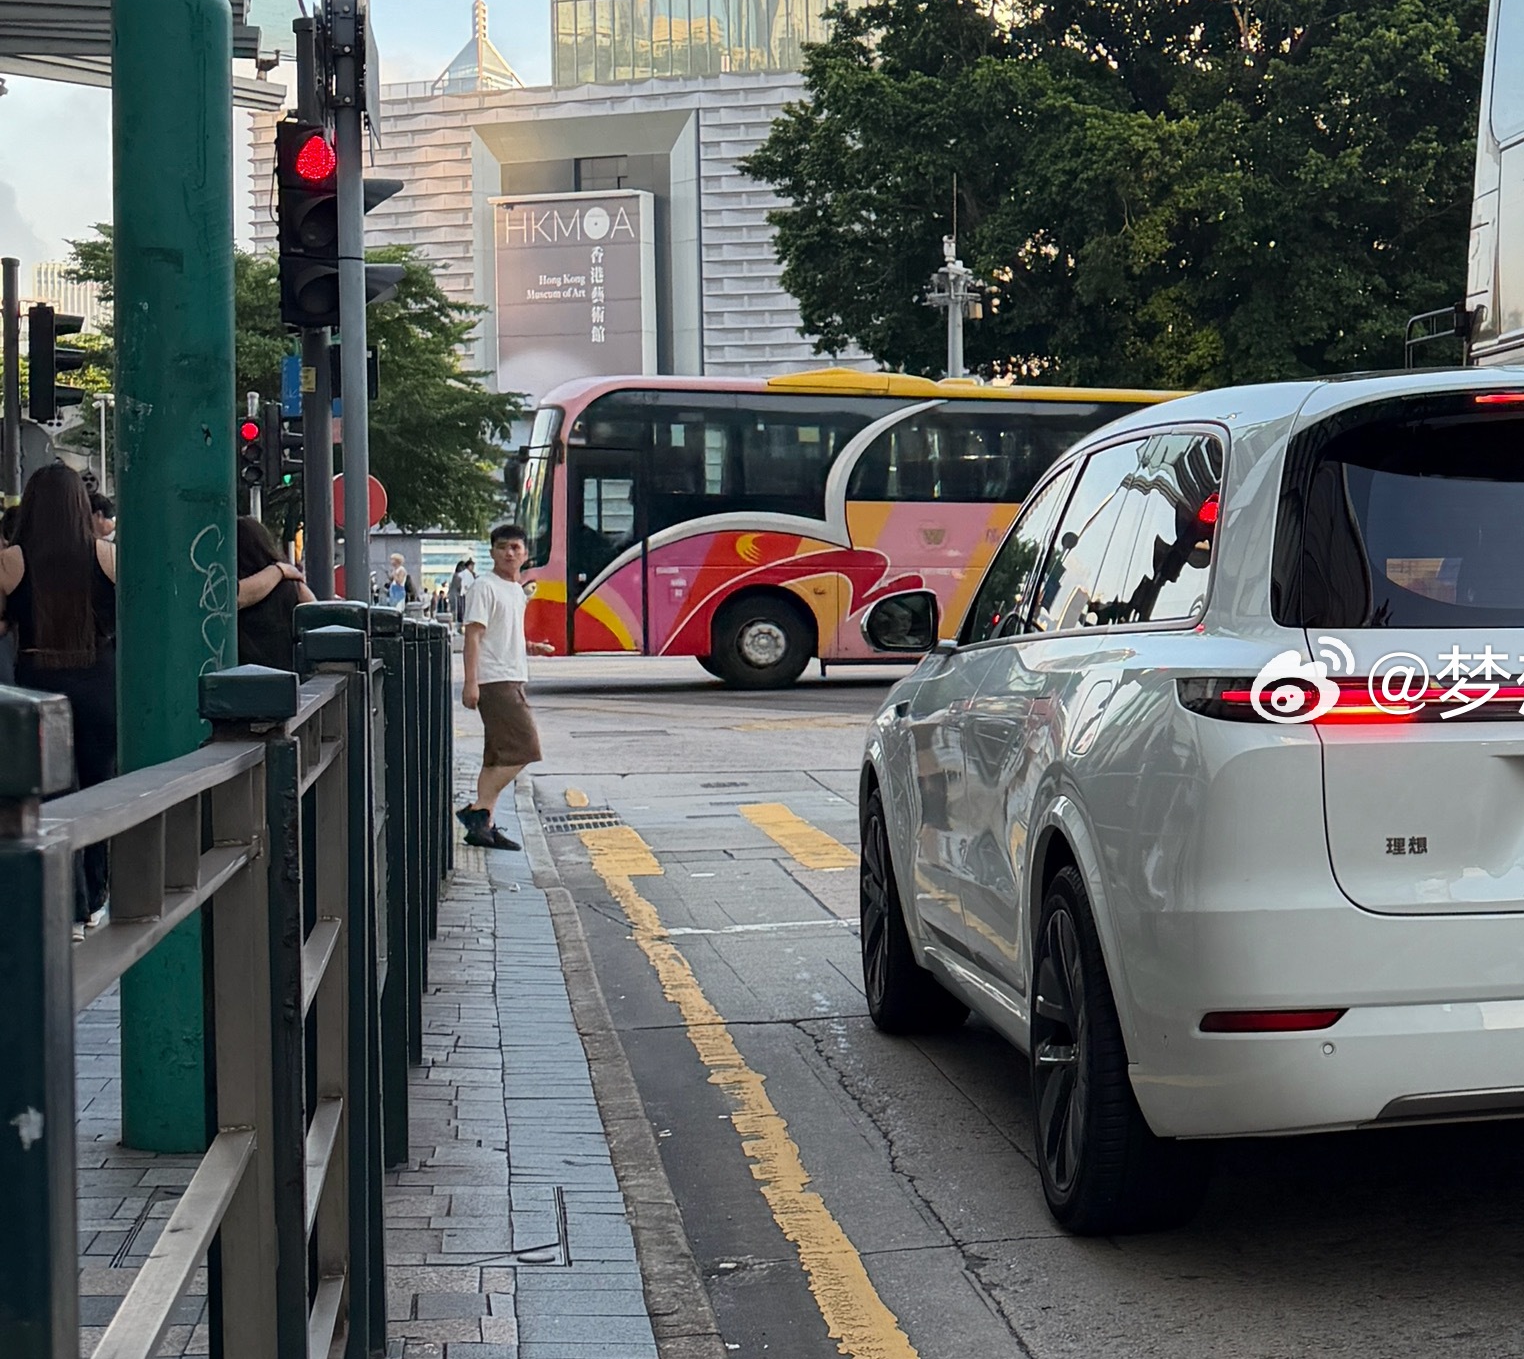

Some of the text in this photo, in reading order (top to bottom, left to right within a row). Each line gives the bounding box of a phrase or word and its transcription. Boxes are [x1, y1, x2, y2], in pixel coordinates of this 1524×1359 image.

[505, 207, 635, 244] HKMOA
[539, 273, 586, 286] Hong Kong
[526, 287, 586, 300] Museum of Art
[590, 246, 605, 342] 香港藝術館
[1386, 836, 1428, 855] 理想
